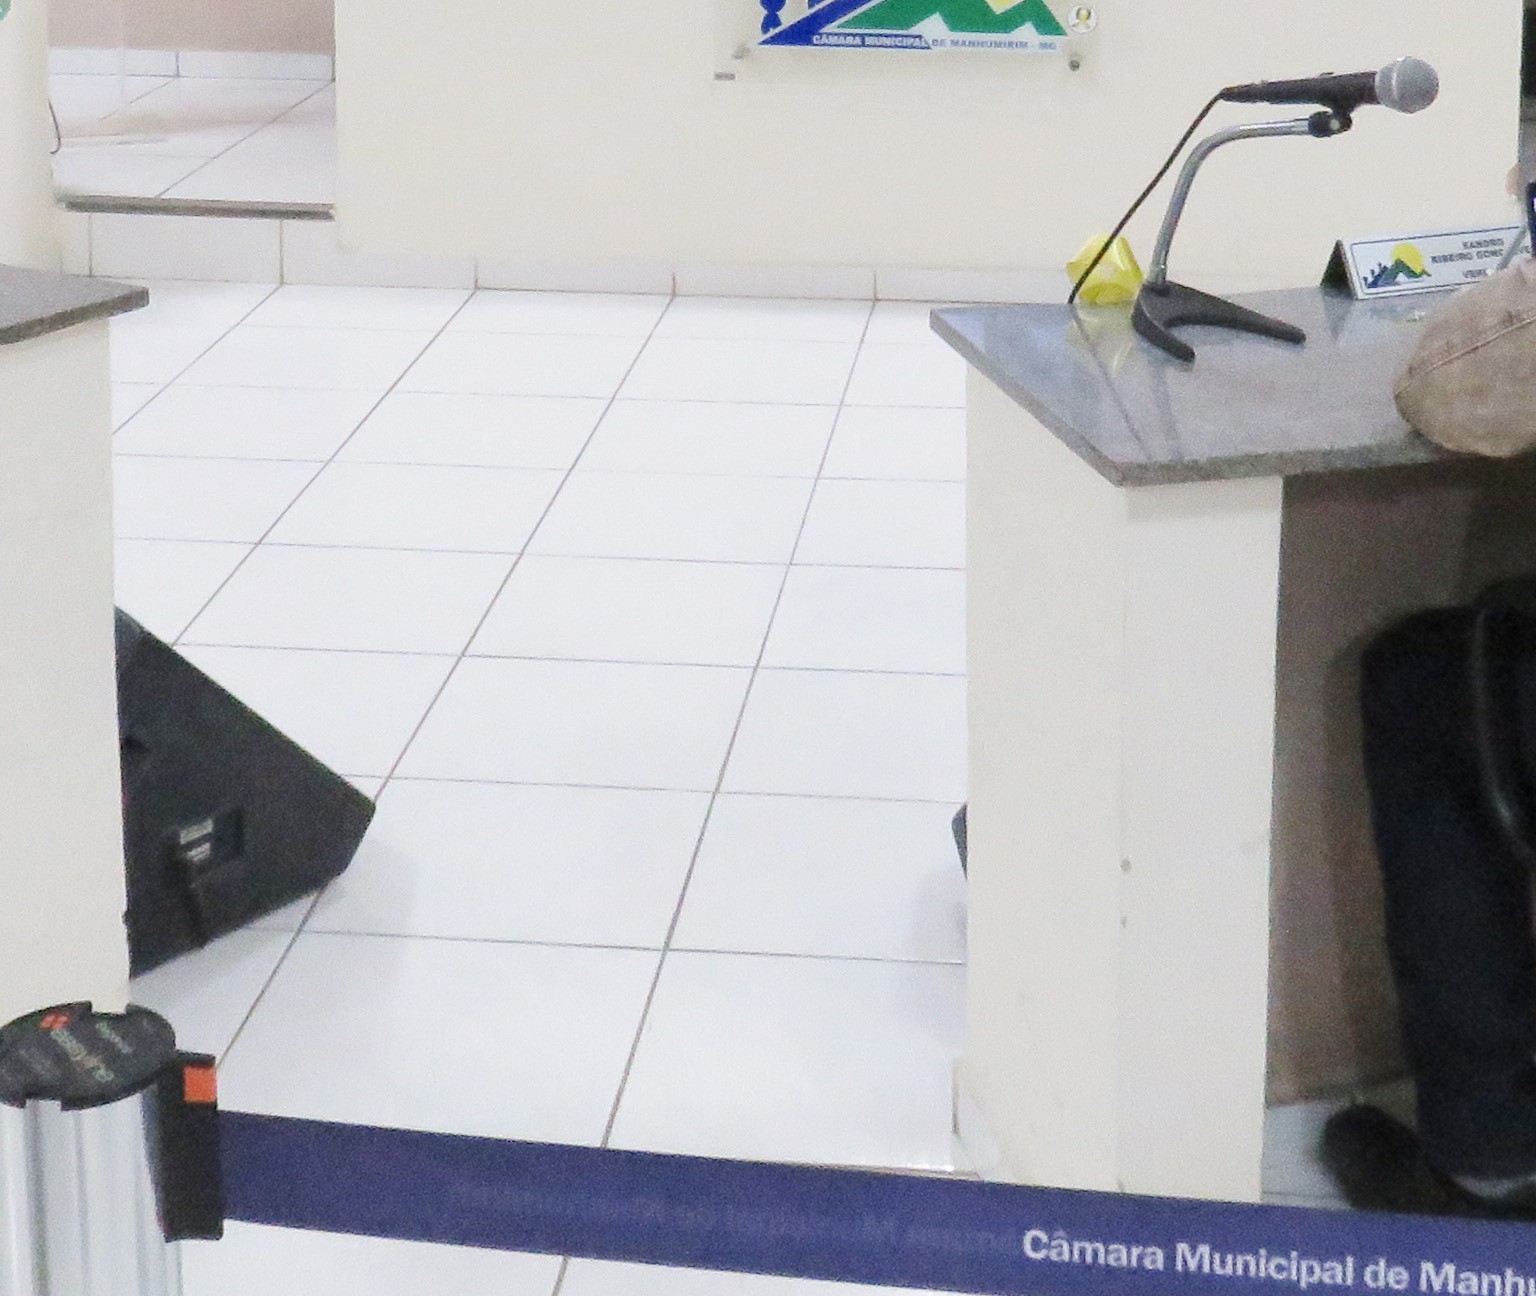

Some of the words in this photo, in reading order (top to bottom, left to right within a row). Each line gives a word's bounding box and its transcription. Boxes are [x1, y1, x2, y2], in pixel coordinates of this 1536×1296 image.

[865, 35, 931, 49] MUNICIPAL
[1022, 1228, 1164, 1271] Câmara
[1174, 1241, 1355, 1290] Municipal
[1363, 1258, 1410, 1290] de
